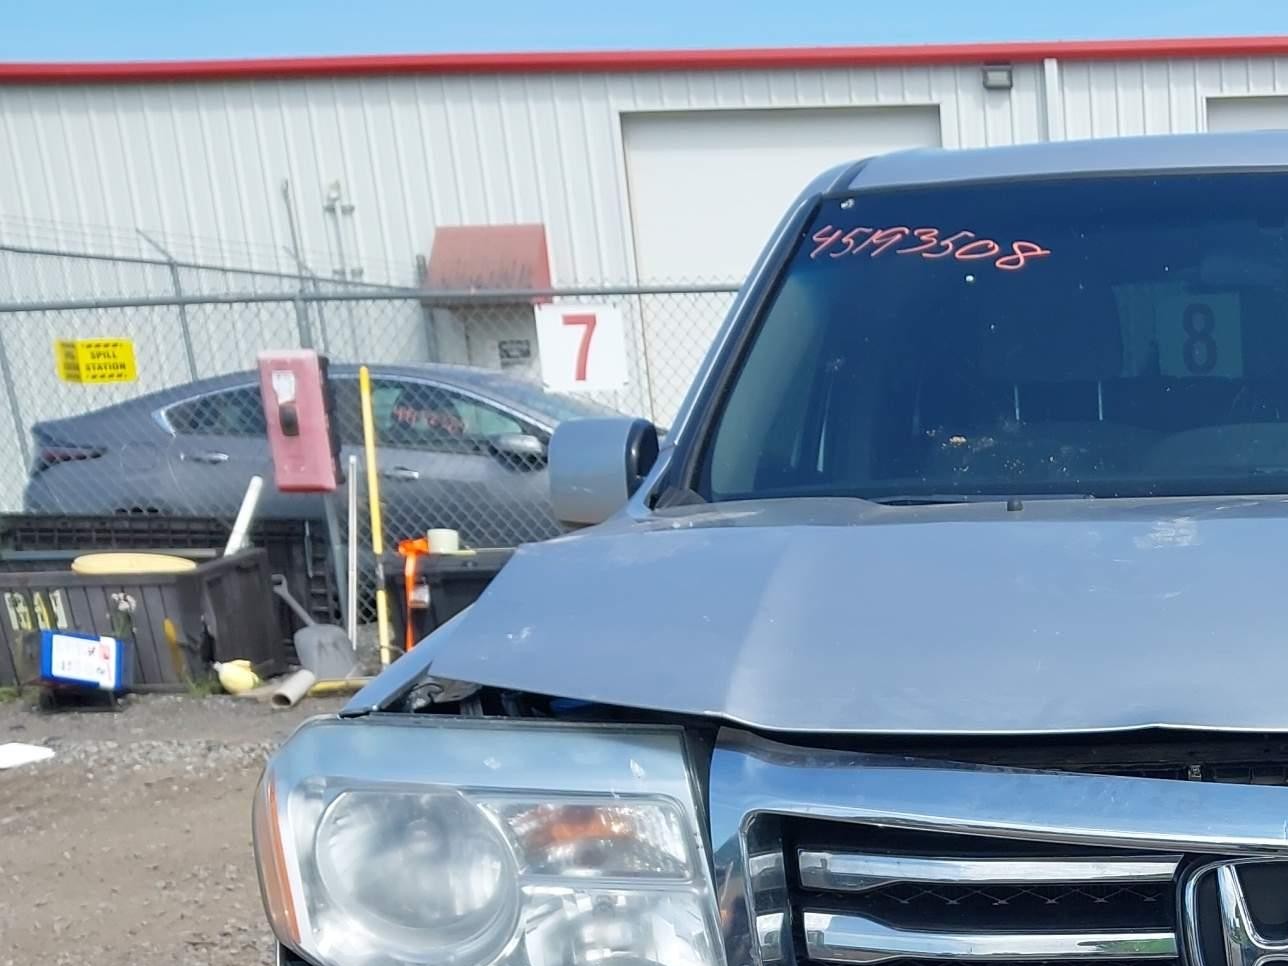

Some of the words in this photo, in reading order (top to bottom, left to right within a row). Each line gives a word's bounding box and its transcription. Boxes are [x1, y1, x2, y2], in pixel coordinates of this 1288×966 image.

[810, 225, 1051, 269] 45193508
[90, 351, 117, 359] SPILL
[562, 314, 597, 381] 7
[1183, 303, 1217, 376] 8
[85, 361, 127, 371] STATION
